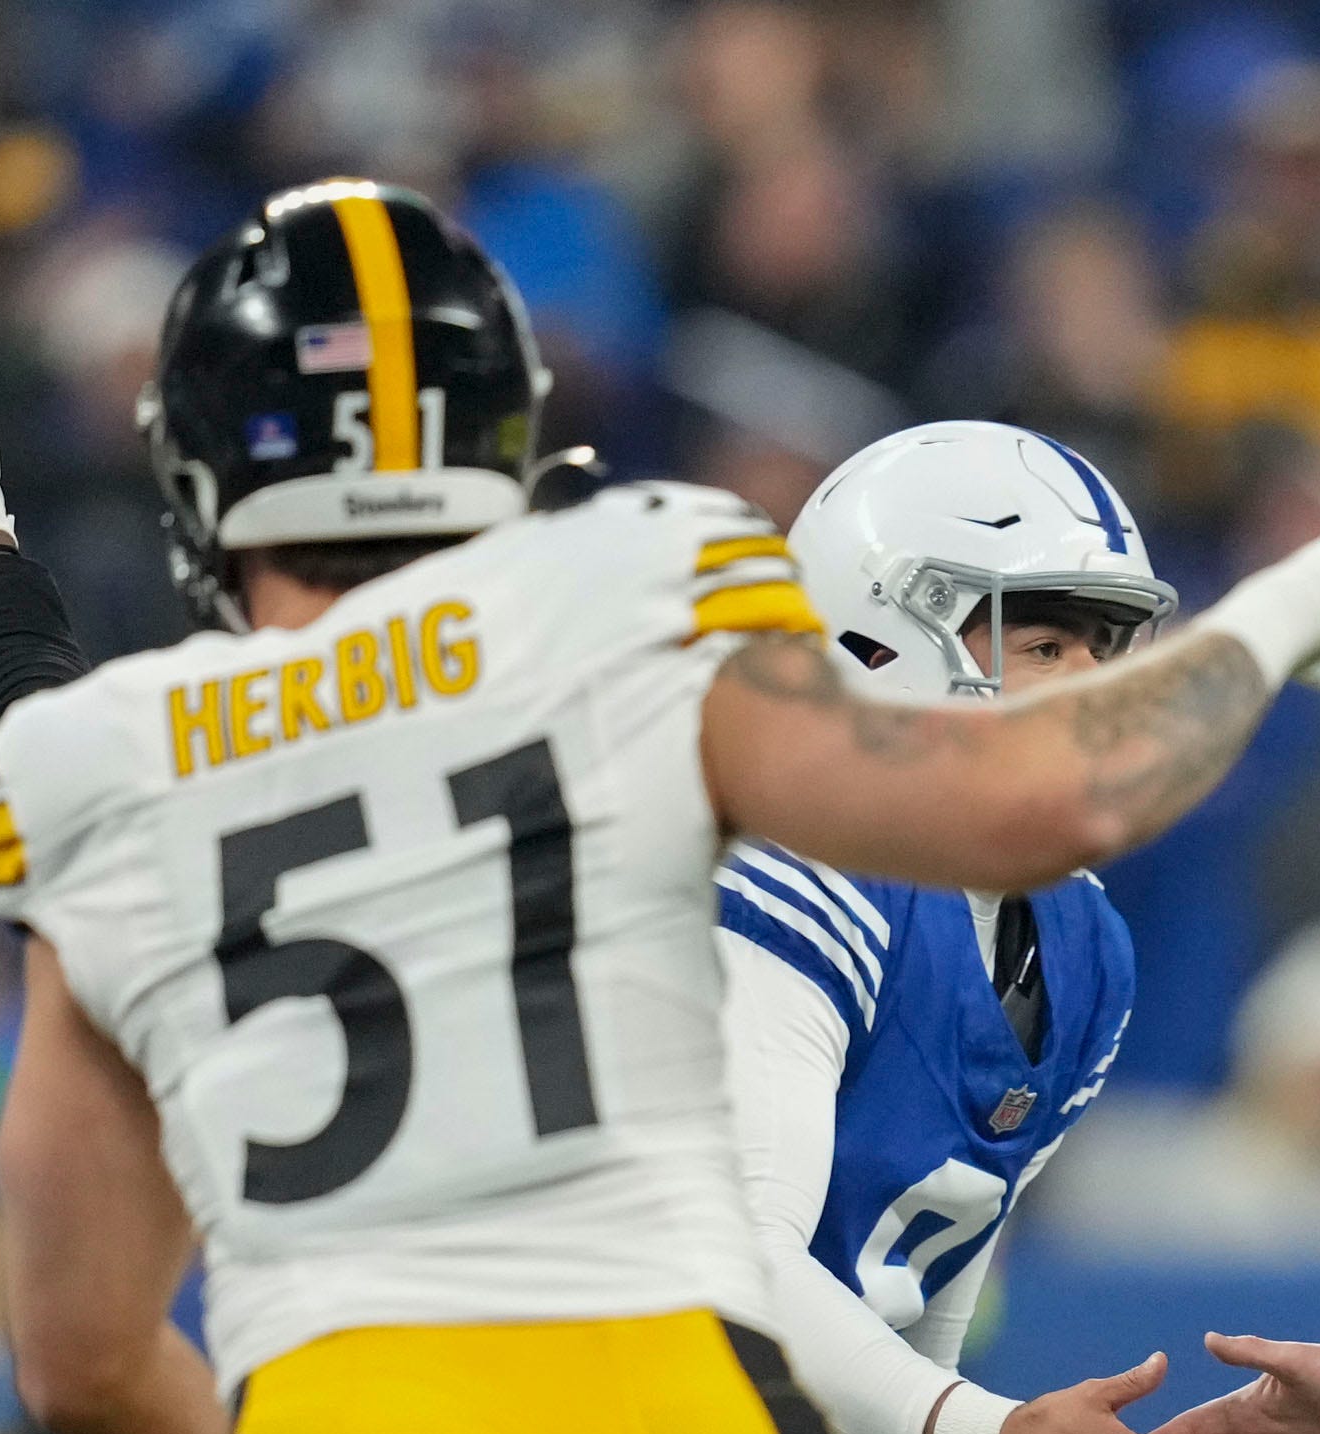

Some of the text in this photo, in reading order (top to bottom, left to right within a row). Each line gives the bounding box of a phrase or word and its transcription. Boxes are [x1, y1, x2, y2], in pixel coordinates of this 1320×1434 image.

[333, 387, 445, 475] 51
[167, 600, 479, 778] HERBIG
[214, 734, 601, 1207] 51
